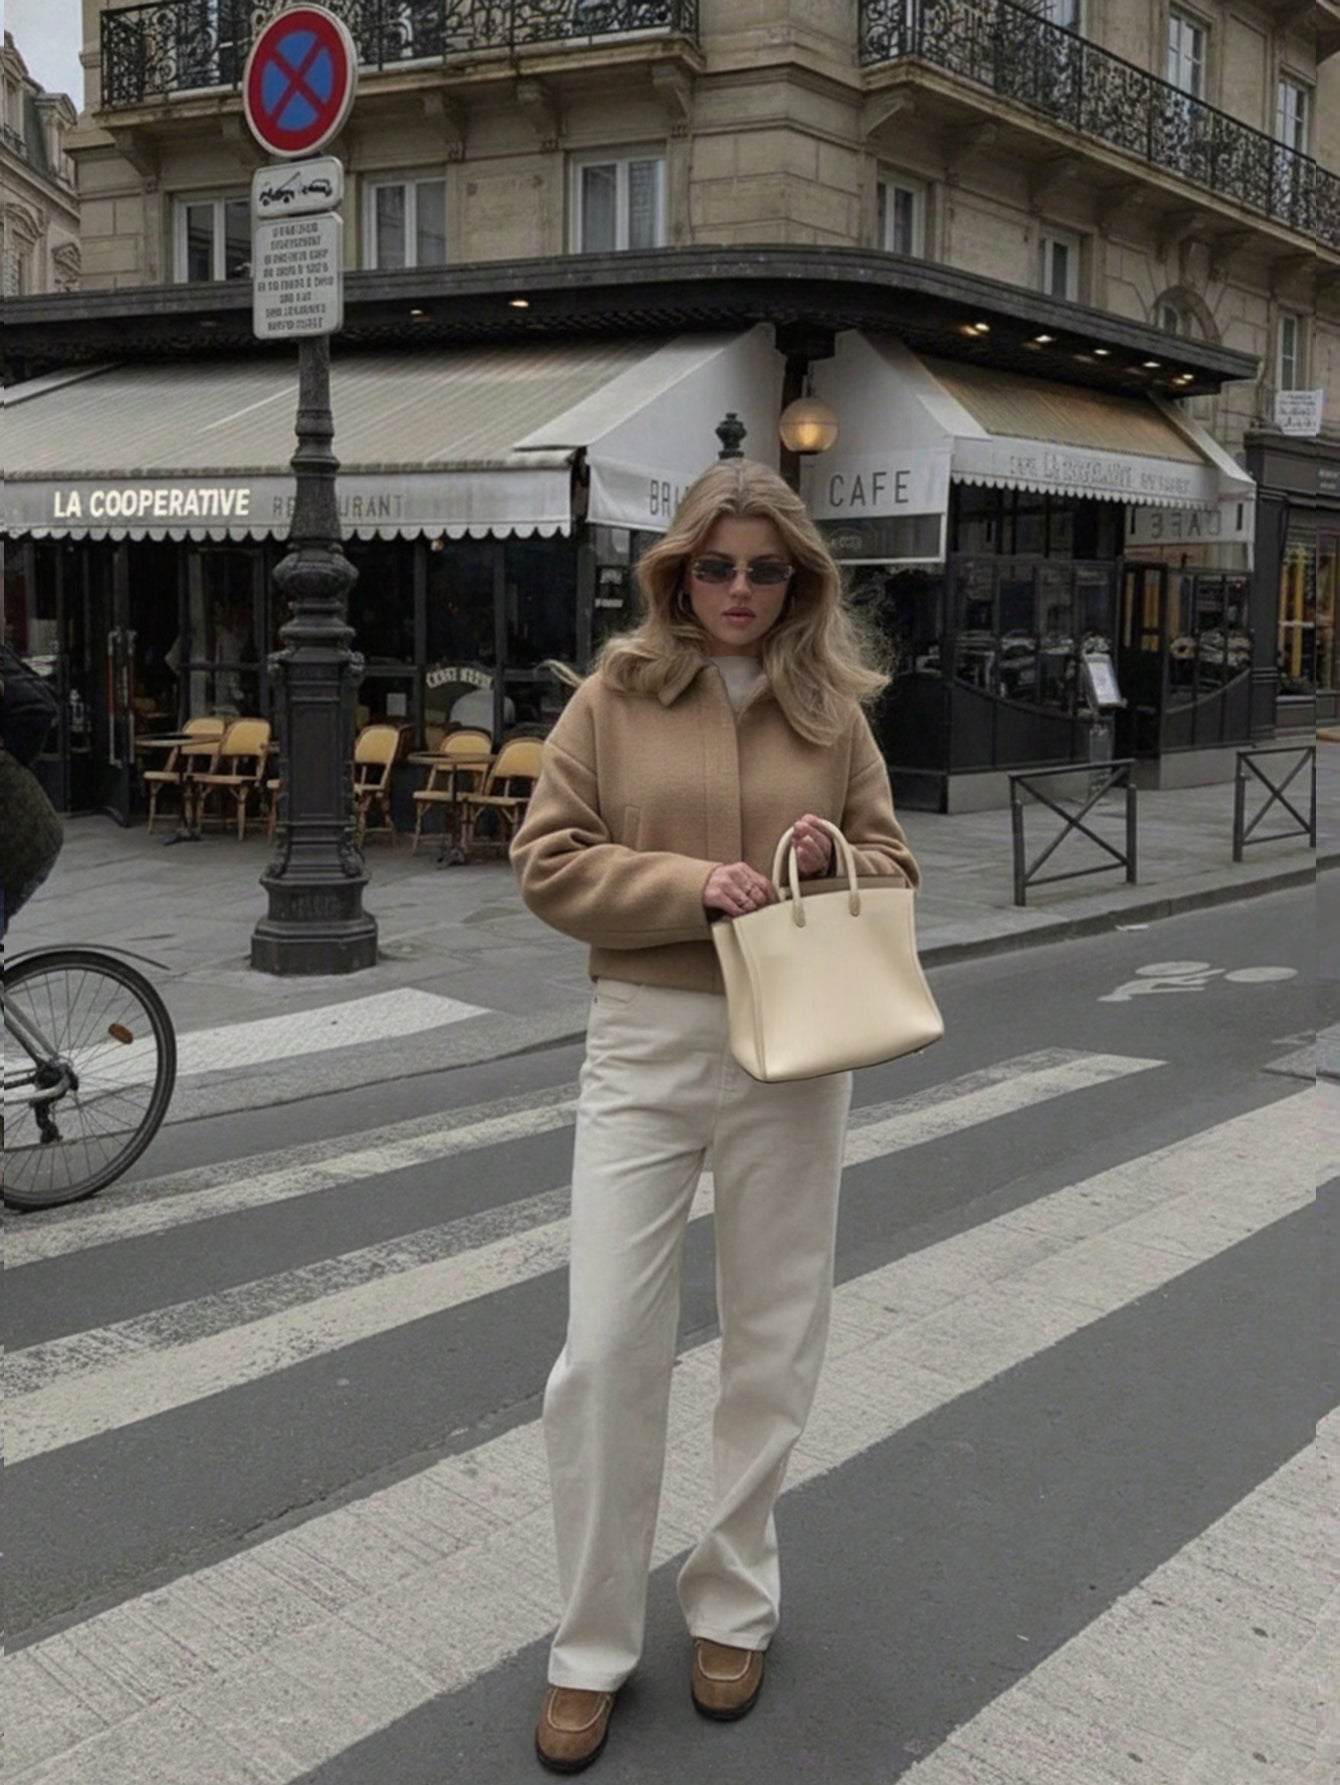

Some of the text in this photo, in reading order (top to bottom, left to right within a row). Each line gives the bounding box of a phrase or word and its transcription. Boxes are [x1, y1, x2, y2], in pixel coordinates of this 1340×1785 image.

[53, 488, 250, 518] LA COOPERATIVE
[829, 470, 911, 508] CAFE
[272, 494, 404, 519] REURANT
